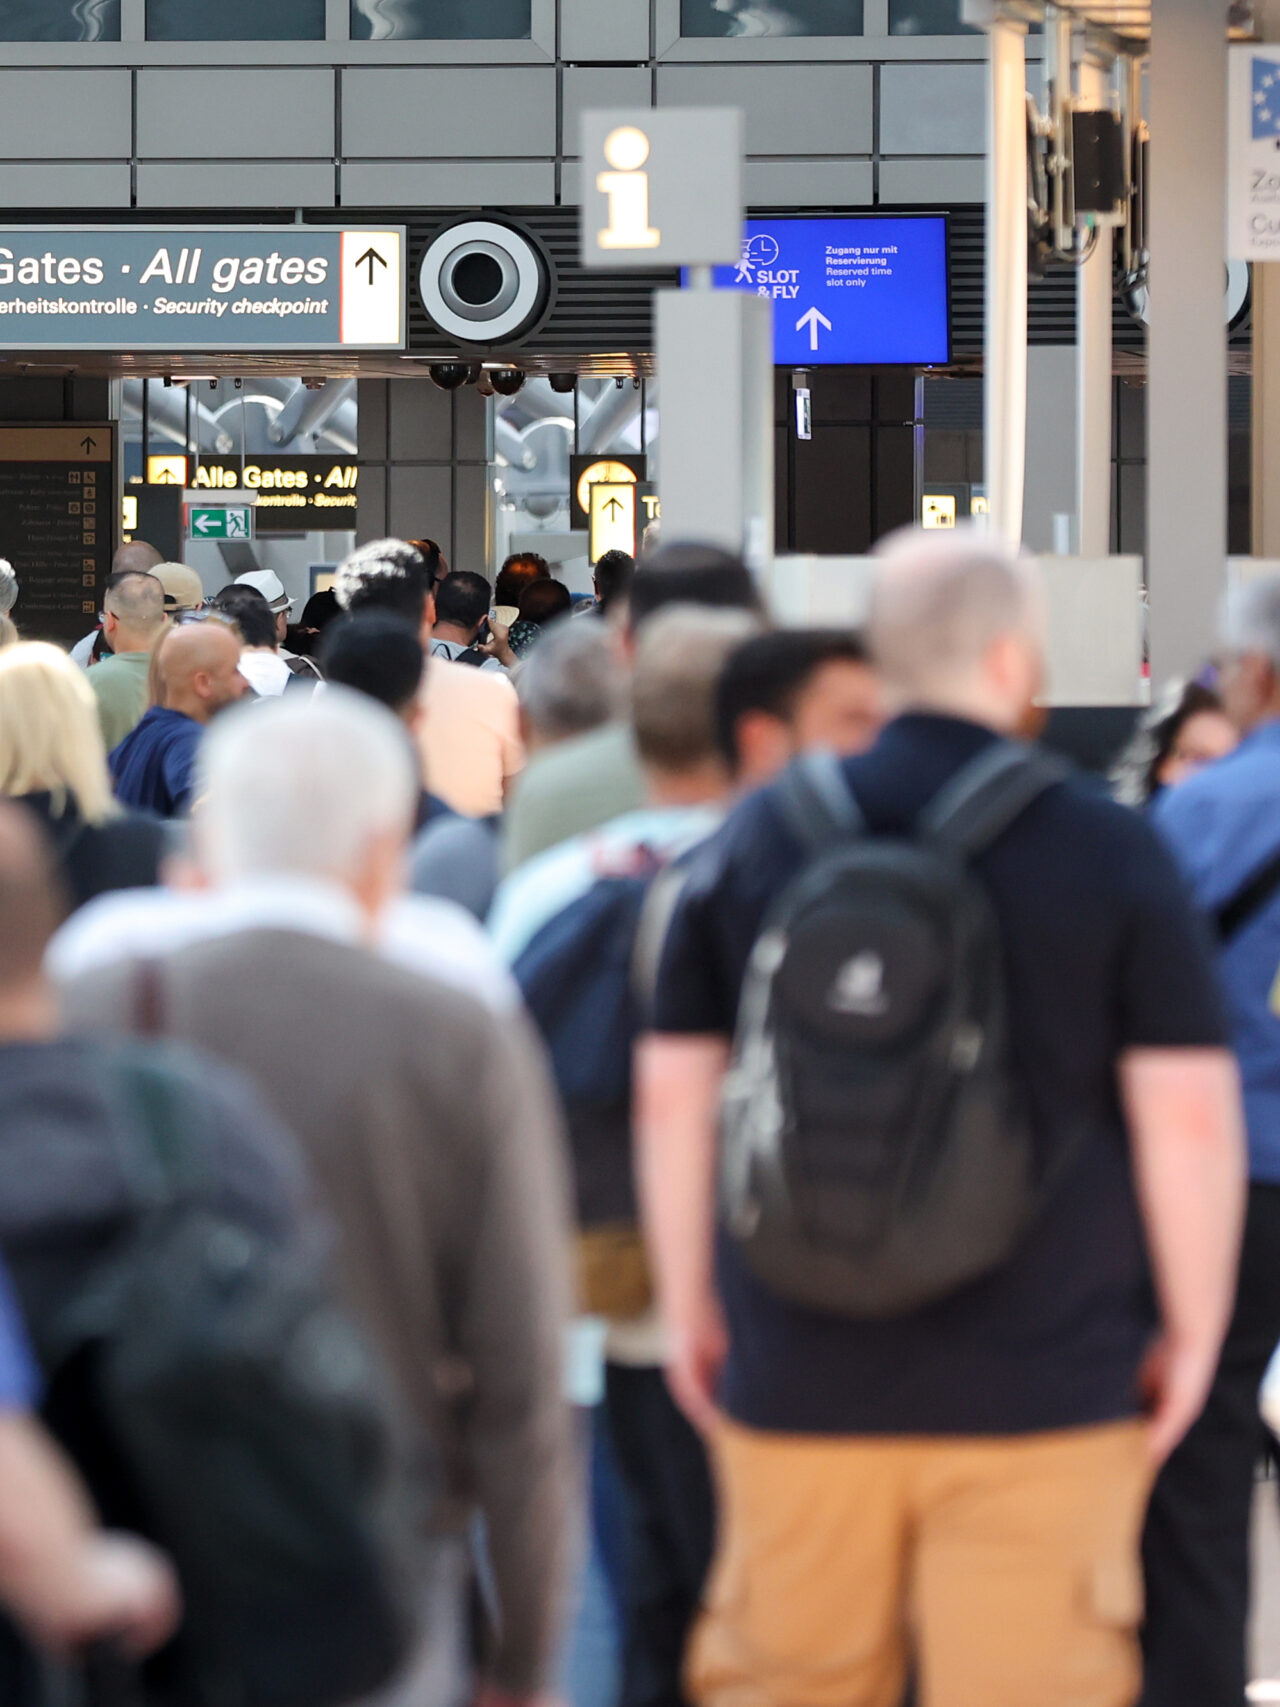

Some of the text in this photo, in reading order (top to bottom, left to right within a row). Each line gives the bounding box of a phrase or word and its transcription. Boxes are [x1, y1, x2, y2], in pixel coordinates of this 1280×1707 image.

[825, 245, 861, 256] Zugang
[881, 245, 898, 254] mit
[825, 256, 887, 266] Reservierung
[139, 248, 202, 284] All
[211, 252, 328, 293] gates
[756, 269, 800, 284] SLOT
[826, 267, 893, 276] Reserved time
[826, 278, 867, 287] slot only
[757, 285, 800, 299] & FLY
[153, 297, 228, 317] Security
[231, 297, 329, 317] checkpoint
[192, 465, 238, 488] Alle
[243, 465, 309, 488] Gates
[324, 465, 358, 488] All
[313, 492, 358, 509] Securit
